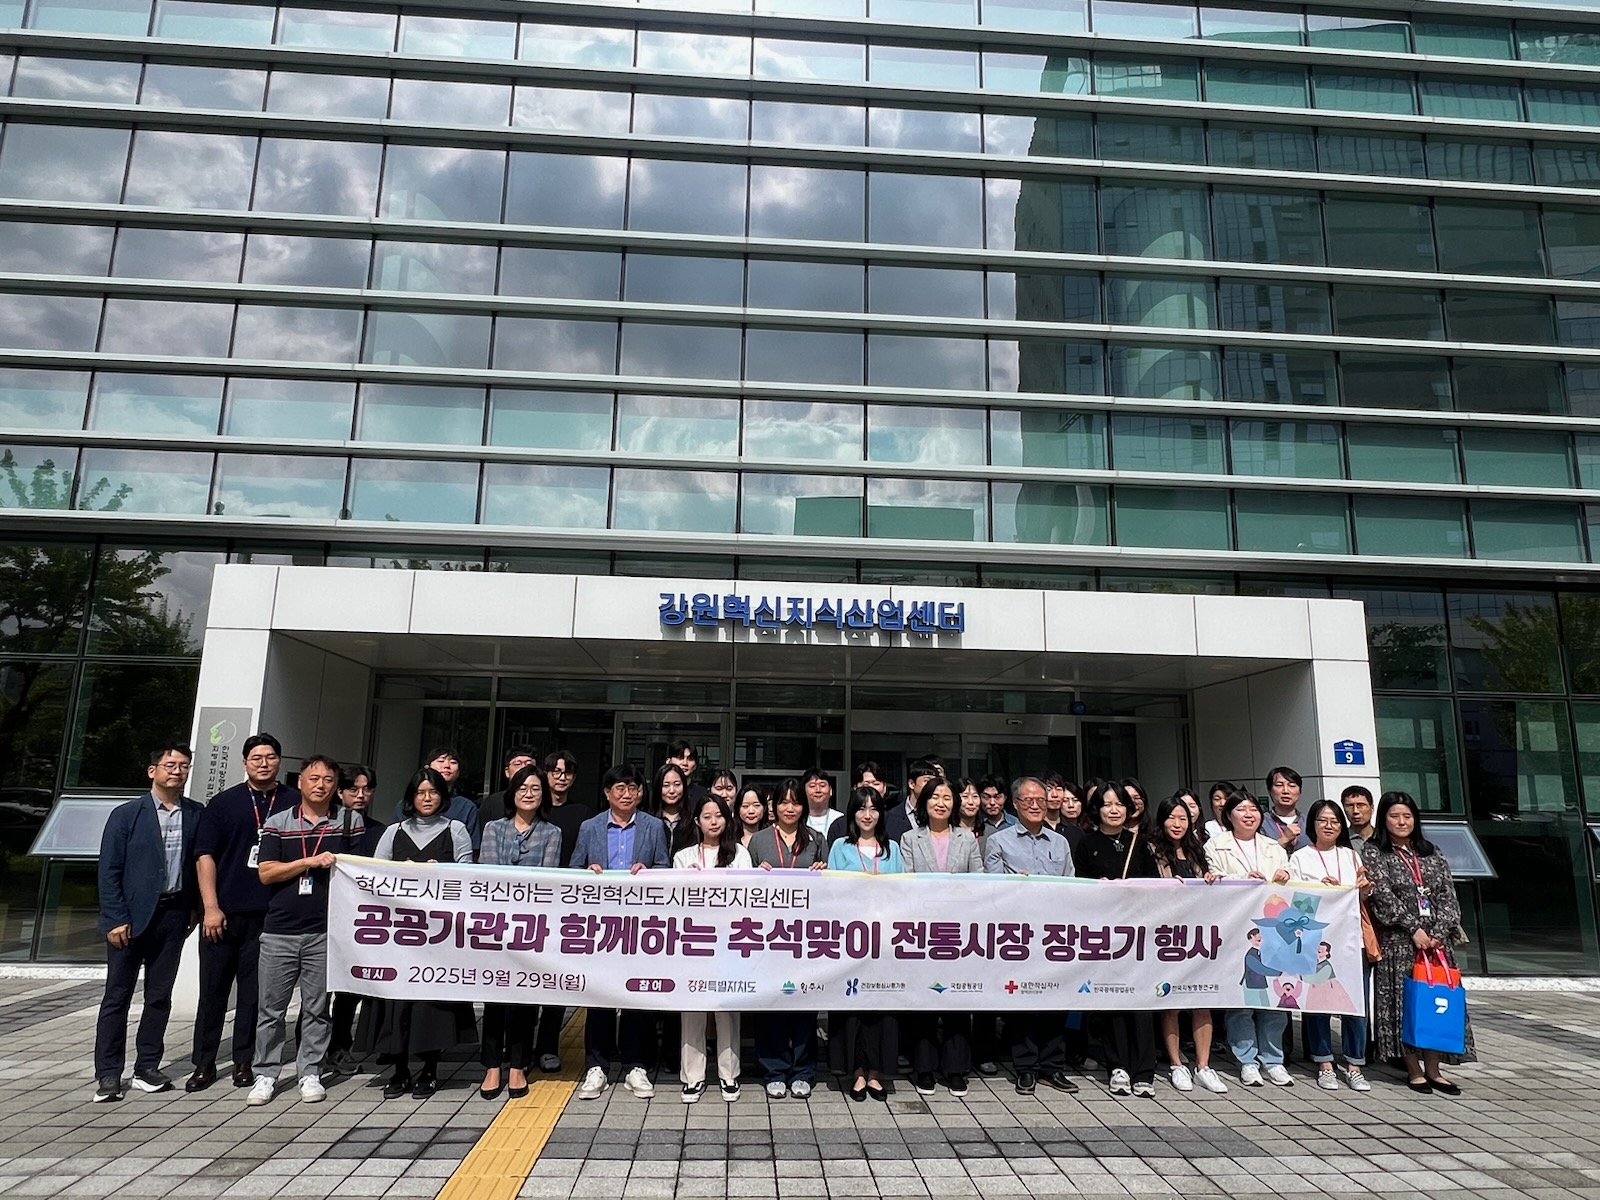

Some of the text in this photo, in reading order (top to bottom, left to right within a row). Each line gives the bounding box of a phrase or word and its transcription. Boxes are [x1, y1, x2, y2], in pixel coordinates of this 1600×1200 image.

[659, 593, 965, 633] 강원혁신지식산업센터
[1345, 752, 1353, 763] 9
[355, 874, 810, 910] 혁신도시를 혁신하는 강원혁신도시발전지원센터
[353, 904, 1223, 962] 공공기관과 함께하는 추석맞이 전통시장 장보기 행사
[361, 966, 587, 992] 일시 2025년 9월 29일(월)
[639, 979, 662, 992] 참여
[687, 979, 756, 993] 강원특별자치도
[1020, 981, 1060, 990] 대한적십자사
[800, 982, 825, 994] 원주시
